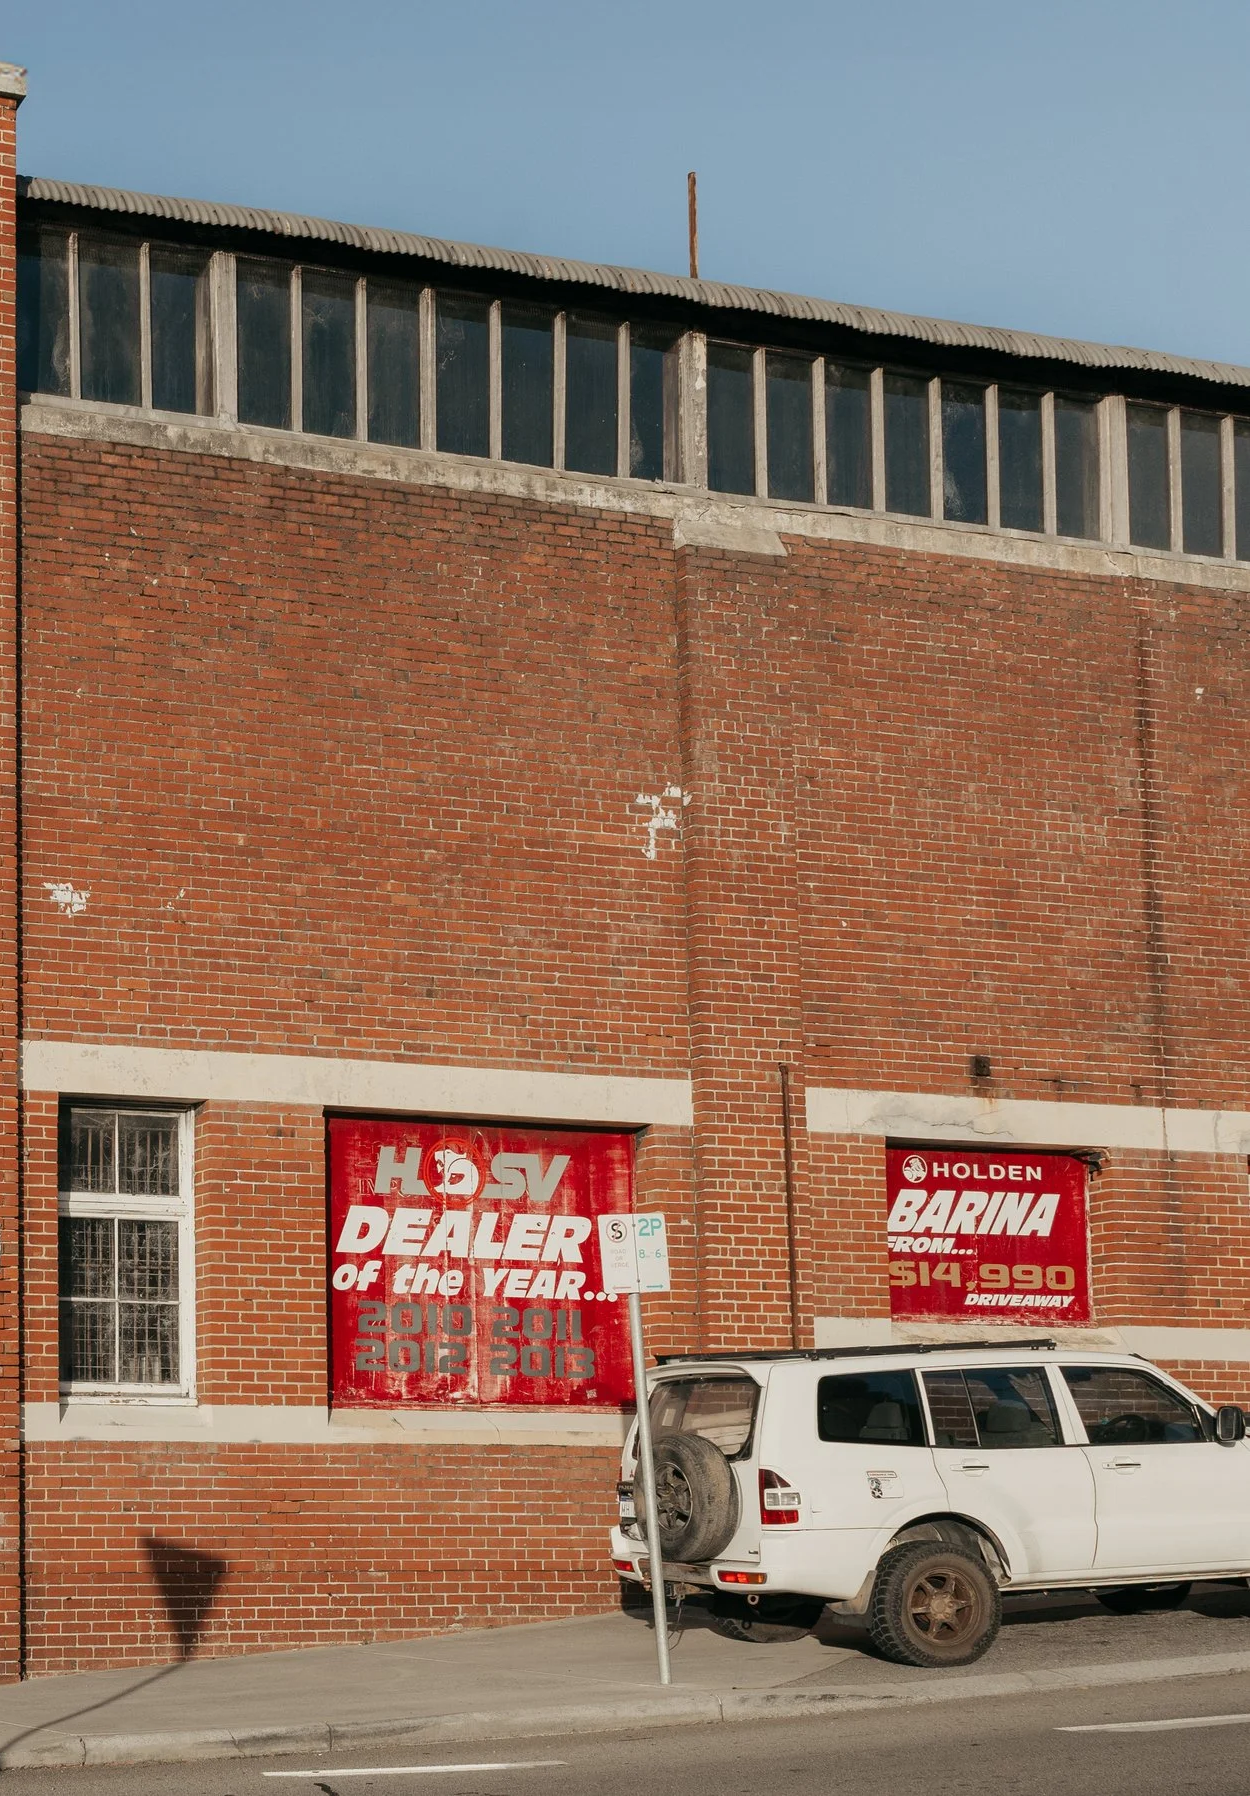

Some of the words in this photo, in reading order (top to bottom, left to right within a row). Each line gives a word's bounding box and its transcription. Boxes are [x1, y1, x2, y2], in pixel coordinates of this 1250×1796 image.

[932, 1162, 1043, 1182] HOLDEN
[637, 1217, 663, 1237] 2P
[887, 1188, 1061, 1237] BARINA
[335, 1205, 592, 1264] DEALER
[887, 1236, 974, 1255] FROM...
[332, 1260, 383, 1291] of
[392, 1263, 464, 1297] the
[482, 1268, 618, 1303] YEAR...
[888, 1261, 1076, 1291] $14,990
[964, 1293, 1076, 1308] DRIVEAWAY
[356, 1301, 474, 1337] 2010
[492, 1307, 583, 1342] 2011
[355, 1339, 467, 1375] 2012
[489, 1344, 596, 1379] 2013
